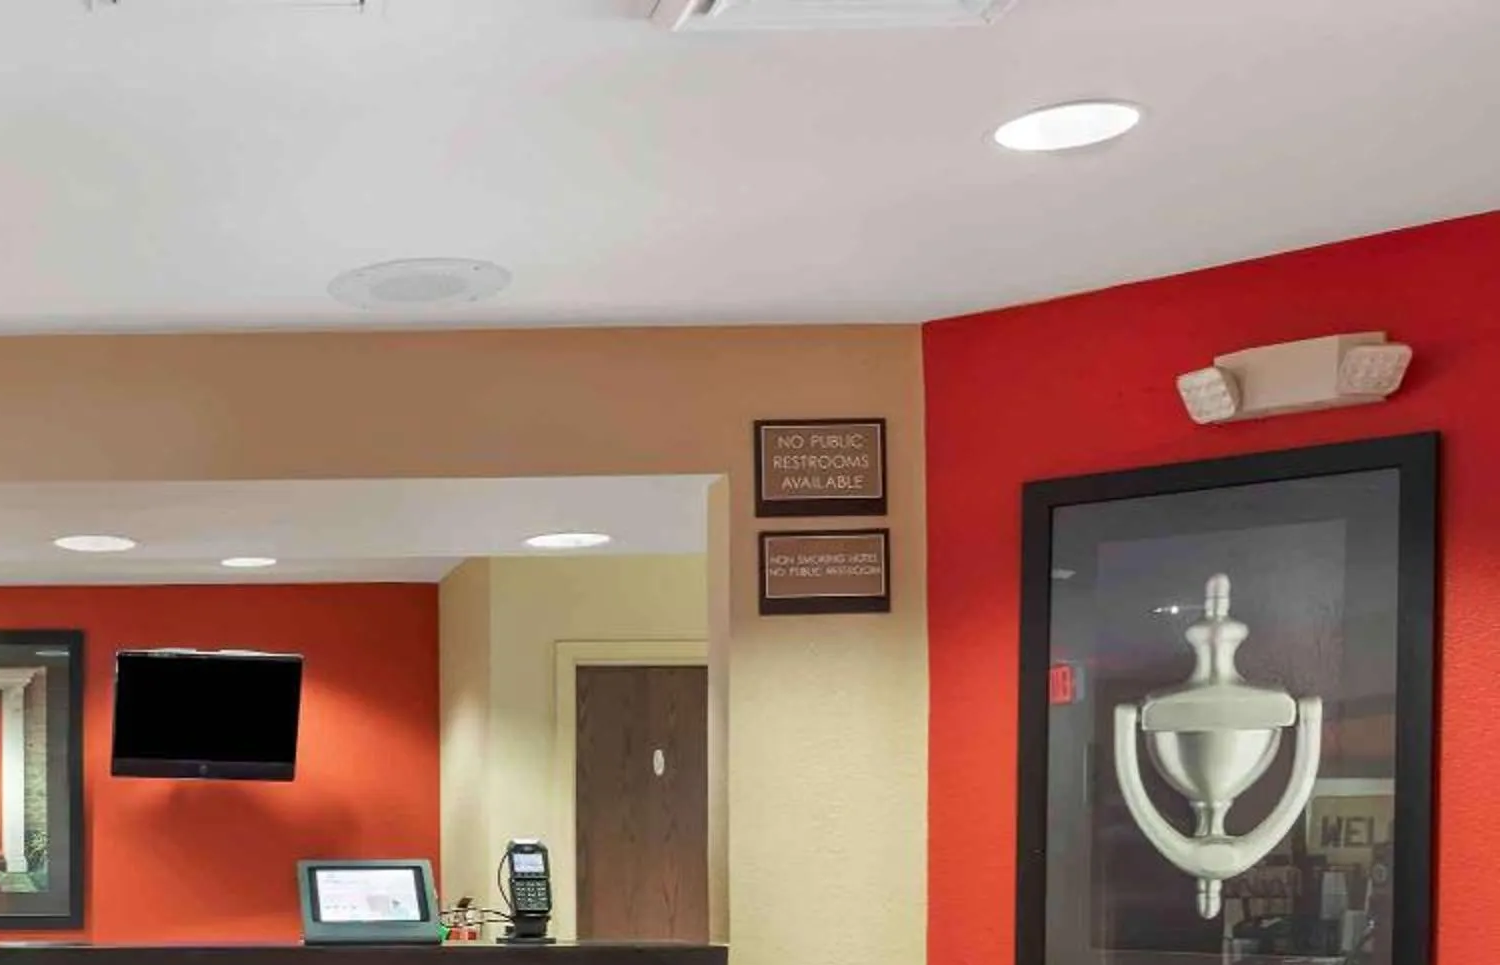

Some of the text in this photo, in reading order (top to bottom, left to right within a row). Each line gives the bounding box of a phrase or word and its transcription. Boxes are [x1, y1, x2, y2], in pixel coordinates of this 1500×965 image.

[778, 433, 864, 449] NO PUBLIC
[773, 455, 869, 470] RESTROOMS
[781, 475, 864, 489] AVAILABLE
